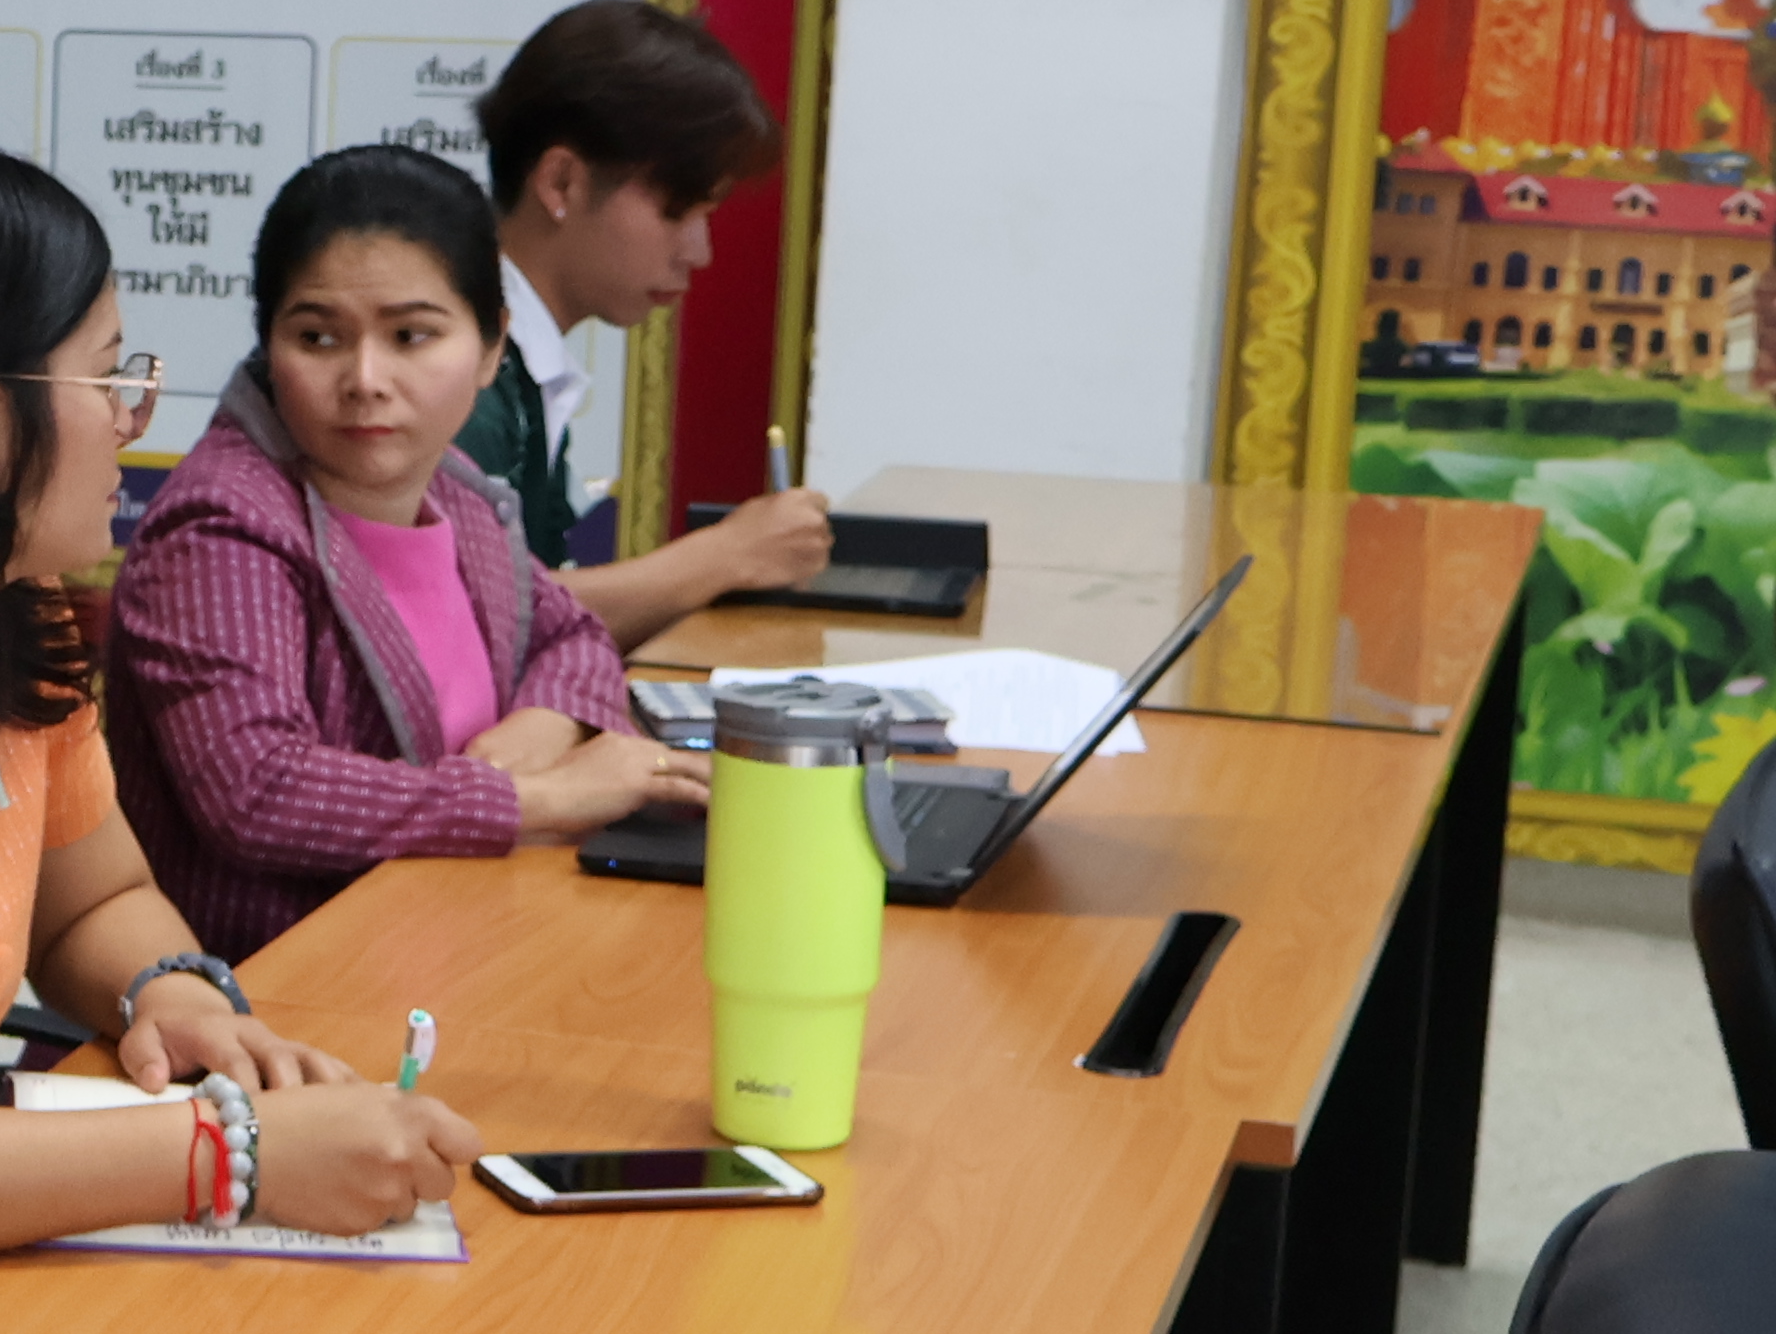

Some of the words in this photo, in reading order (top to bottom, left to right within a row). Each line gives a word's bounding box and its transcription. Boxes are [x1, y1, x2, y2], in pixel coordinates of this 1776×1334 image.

[212, 59, 226, 79] 3
[103, 107, 262, 147] เสริมสร้าง
[111, 165, 251, 208] ทุนชุมชน
[147, 203, 209, 246] ให้มี
